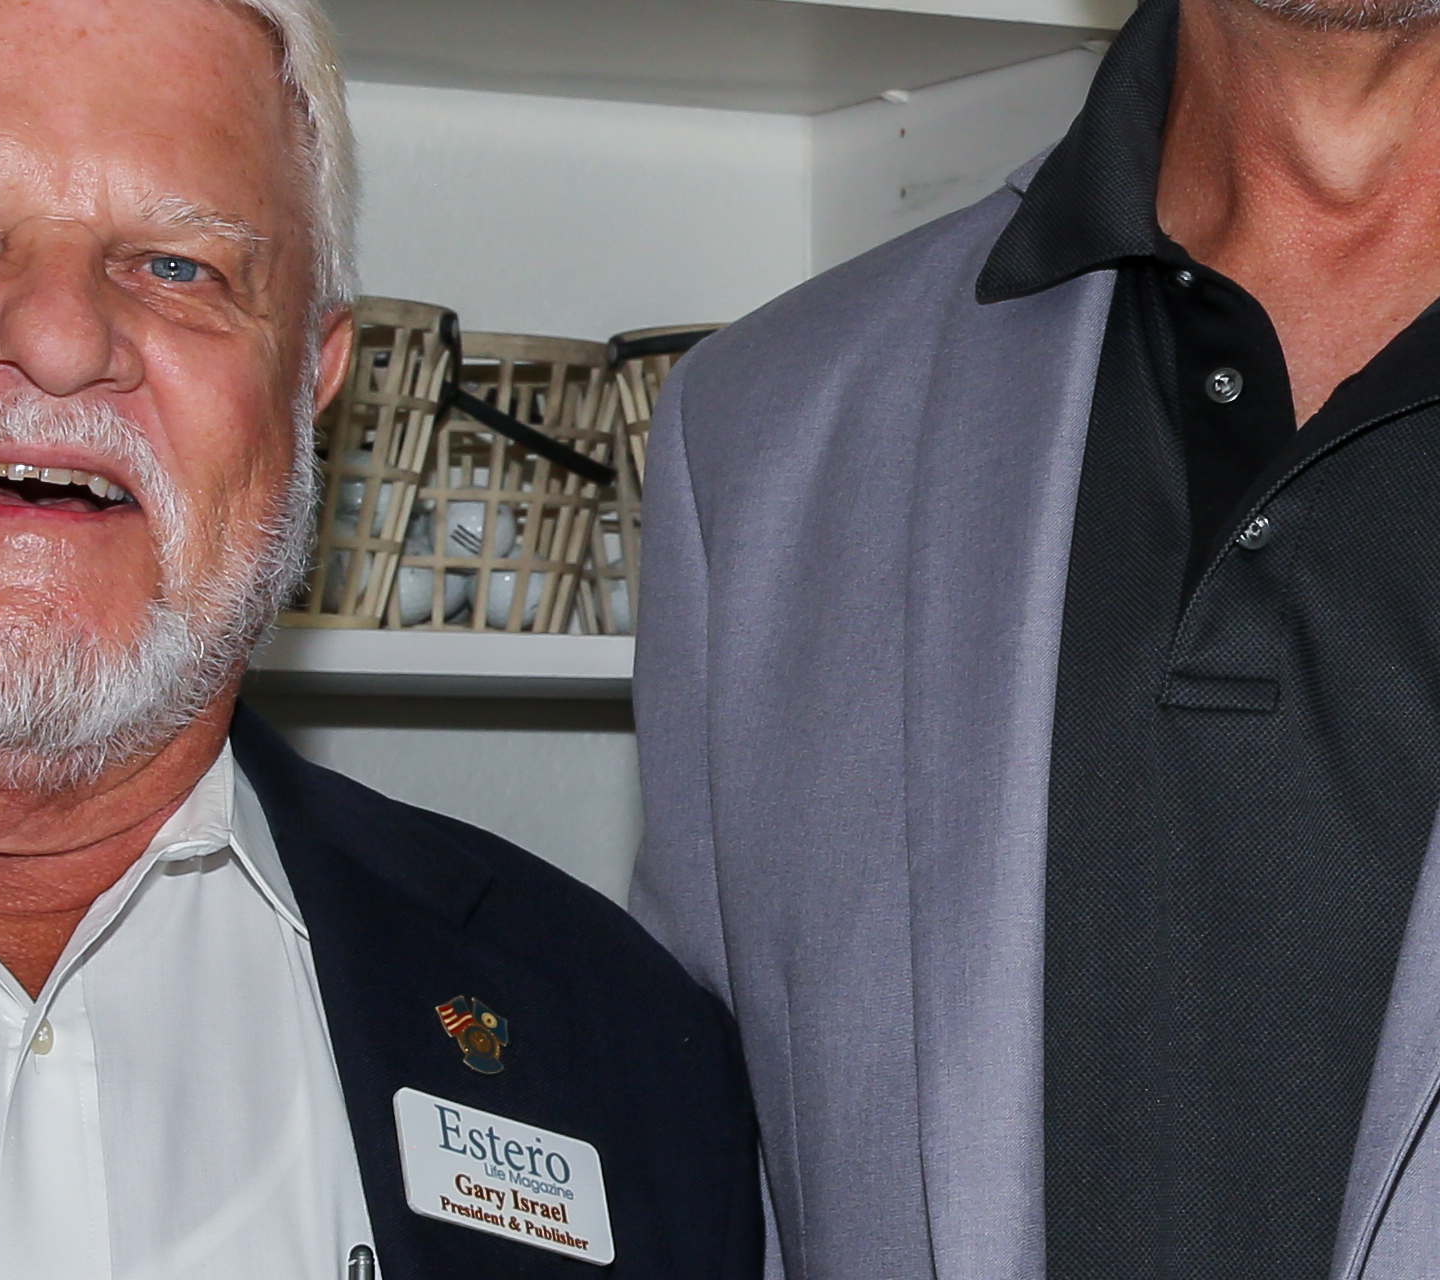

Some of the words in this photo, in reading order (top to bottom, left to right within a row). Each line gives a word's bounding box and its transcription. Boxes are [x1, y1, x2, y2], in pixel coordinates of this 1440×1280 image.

[433, 1103, 571, 1185] Estero
[454, 1173, 506, 1211] Gary
[510, 1188, 569, 1225] Israel
[484, 1162, 506, 1182] Life
[509, 1170, 575, 1201] Magazine
[440, 1195, 506, 1228] President
[508, 1215, 522, 1233] &
[524, 1219, 589, 1252] Publisher
